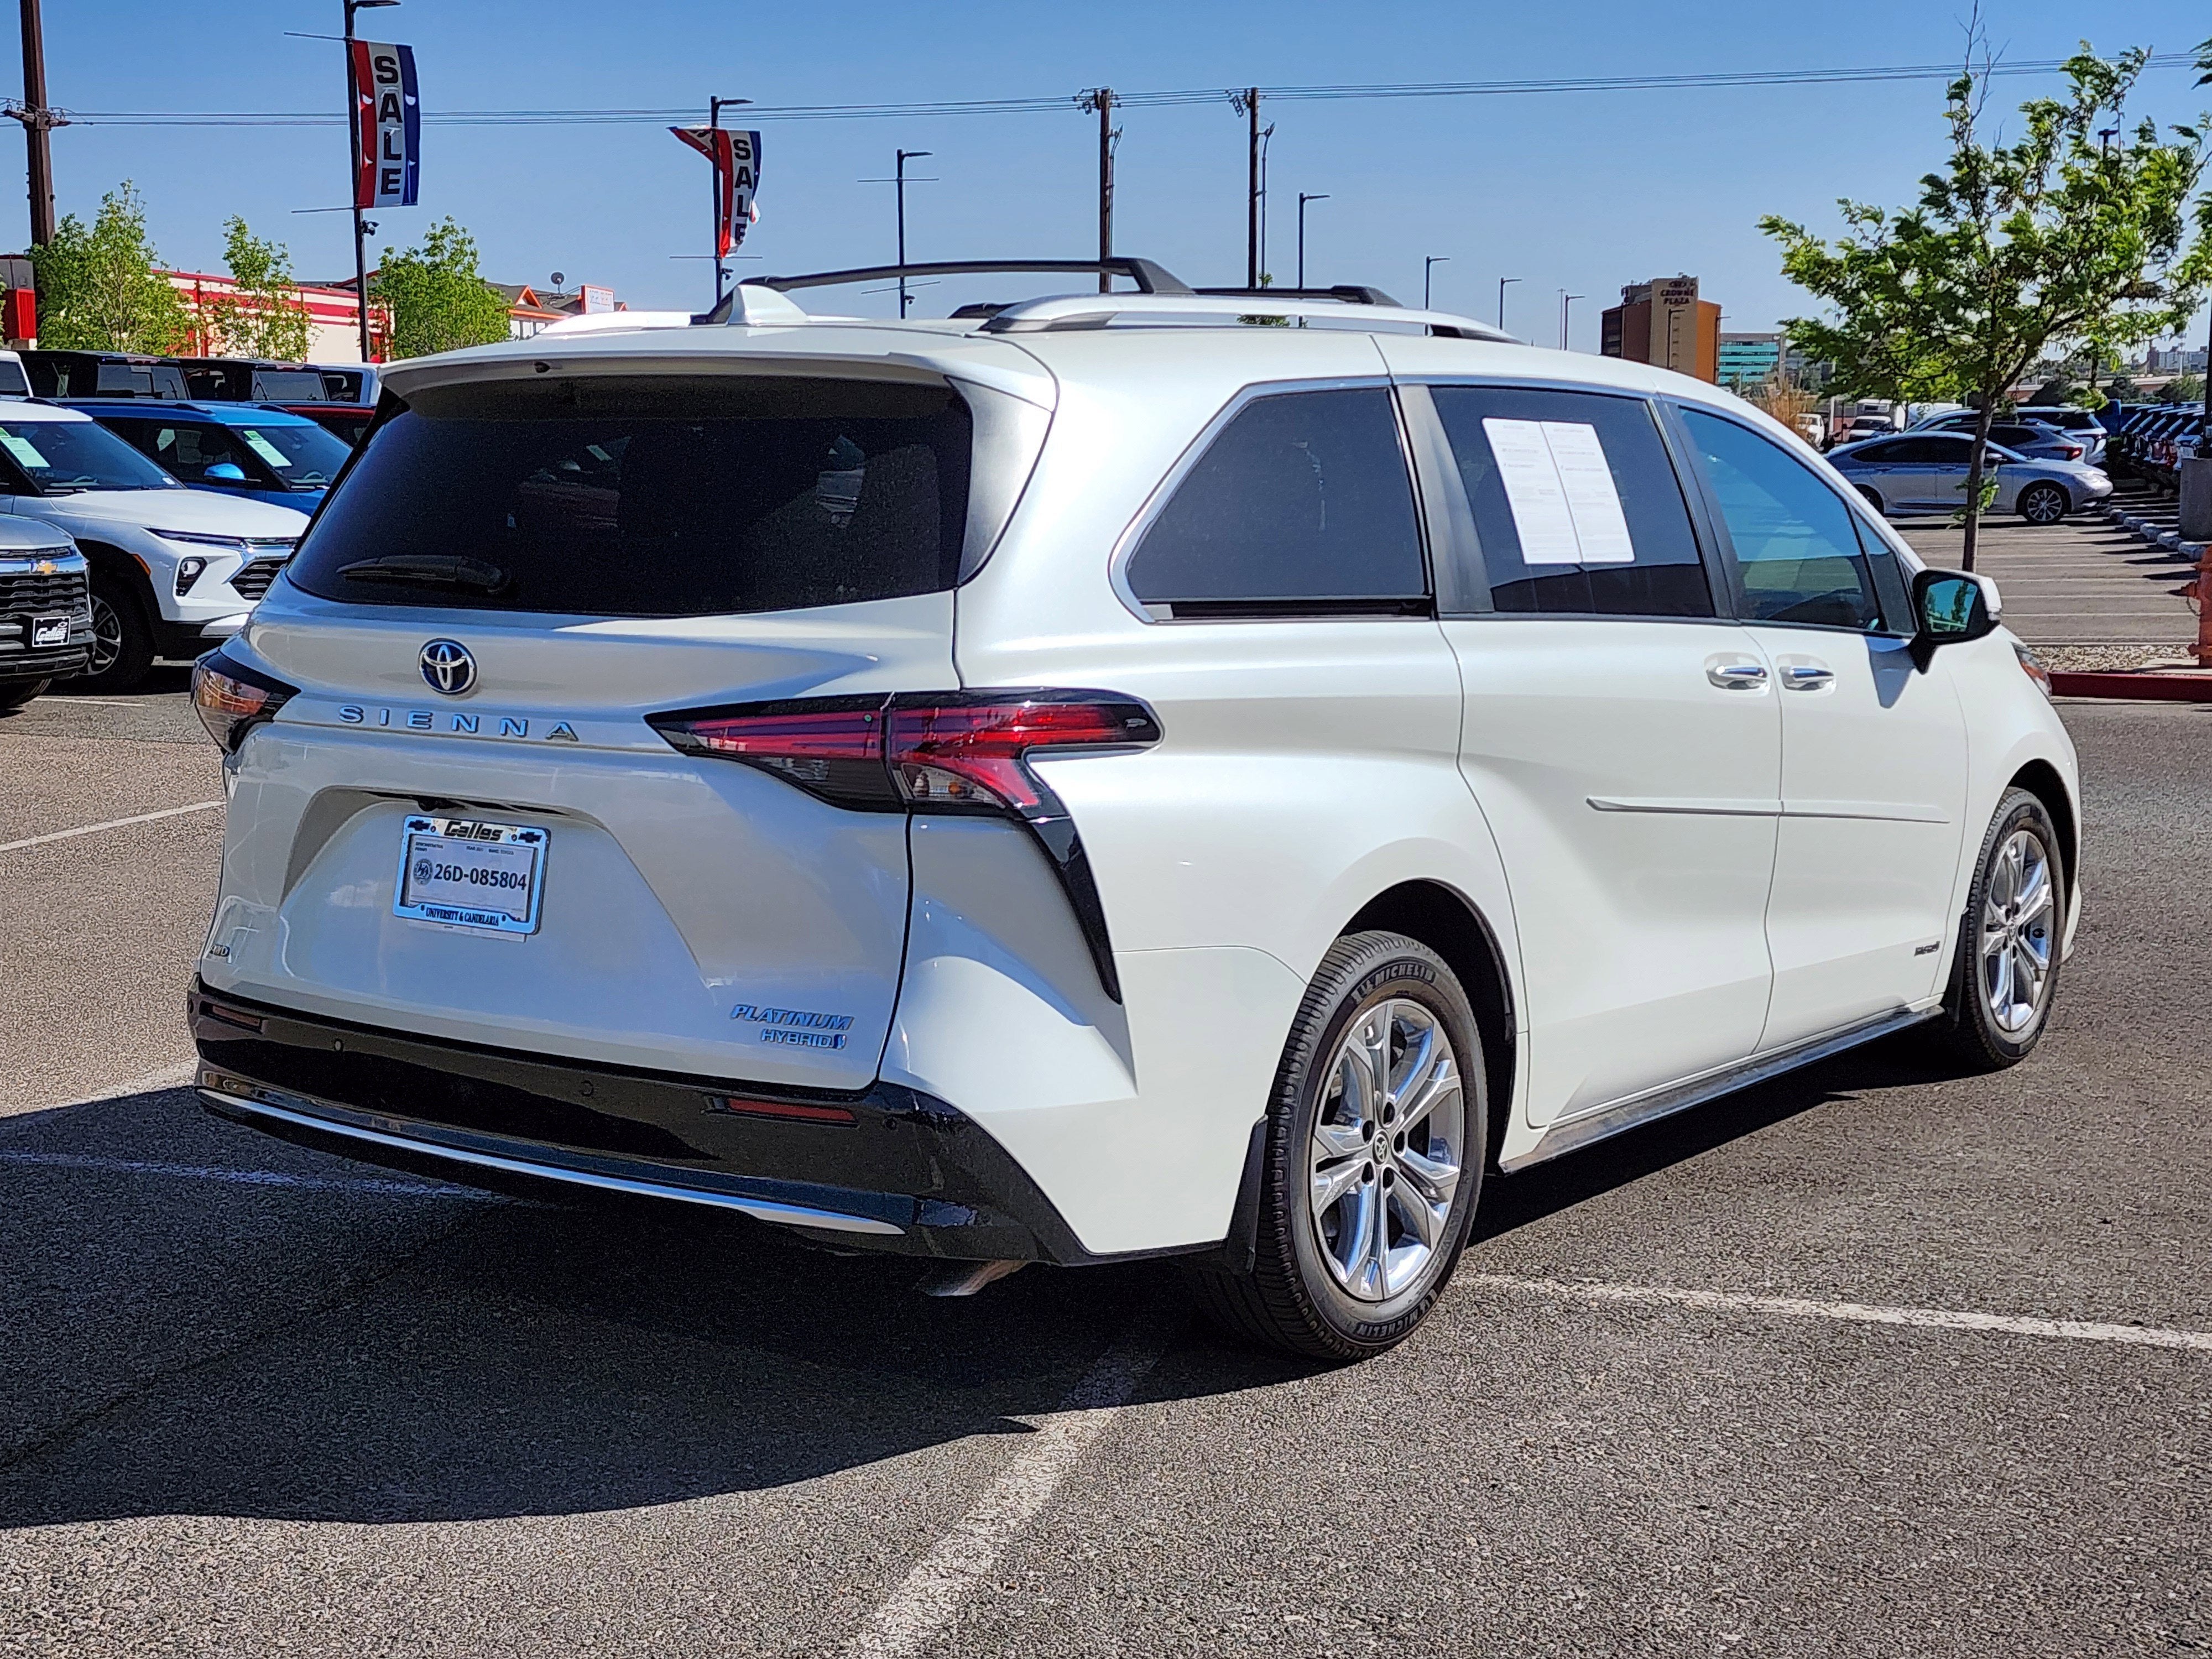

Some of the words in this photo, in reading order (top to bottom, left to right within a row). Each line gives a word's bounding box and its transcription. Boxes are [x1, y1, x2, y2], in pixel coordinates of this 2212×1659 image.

[374, 56, 403, 195] SALE
[733, 139, 753, 245] SALE
[339, 706, 578, 742] SIENNA
[444, 821, 503, 841] Galles
[434, 864, 526, 890] 26D-085804
[426, 907, 459, 920] UNIVERSITY
[459, 911, 463, 921] &
[465, 912, 499, 926] CANDELARIA
[1374, 963, 1436, 987] MICHELIN
[730, 1004, 854, 1030] PLATINUM
[761, 1029, 832, 1048] HYBRID
